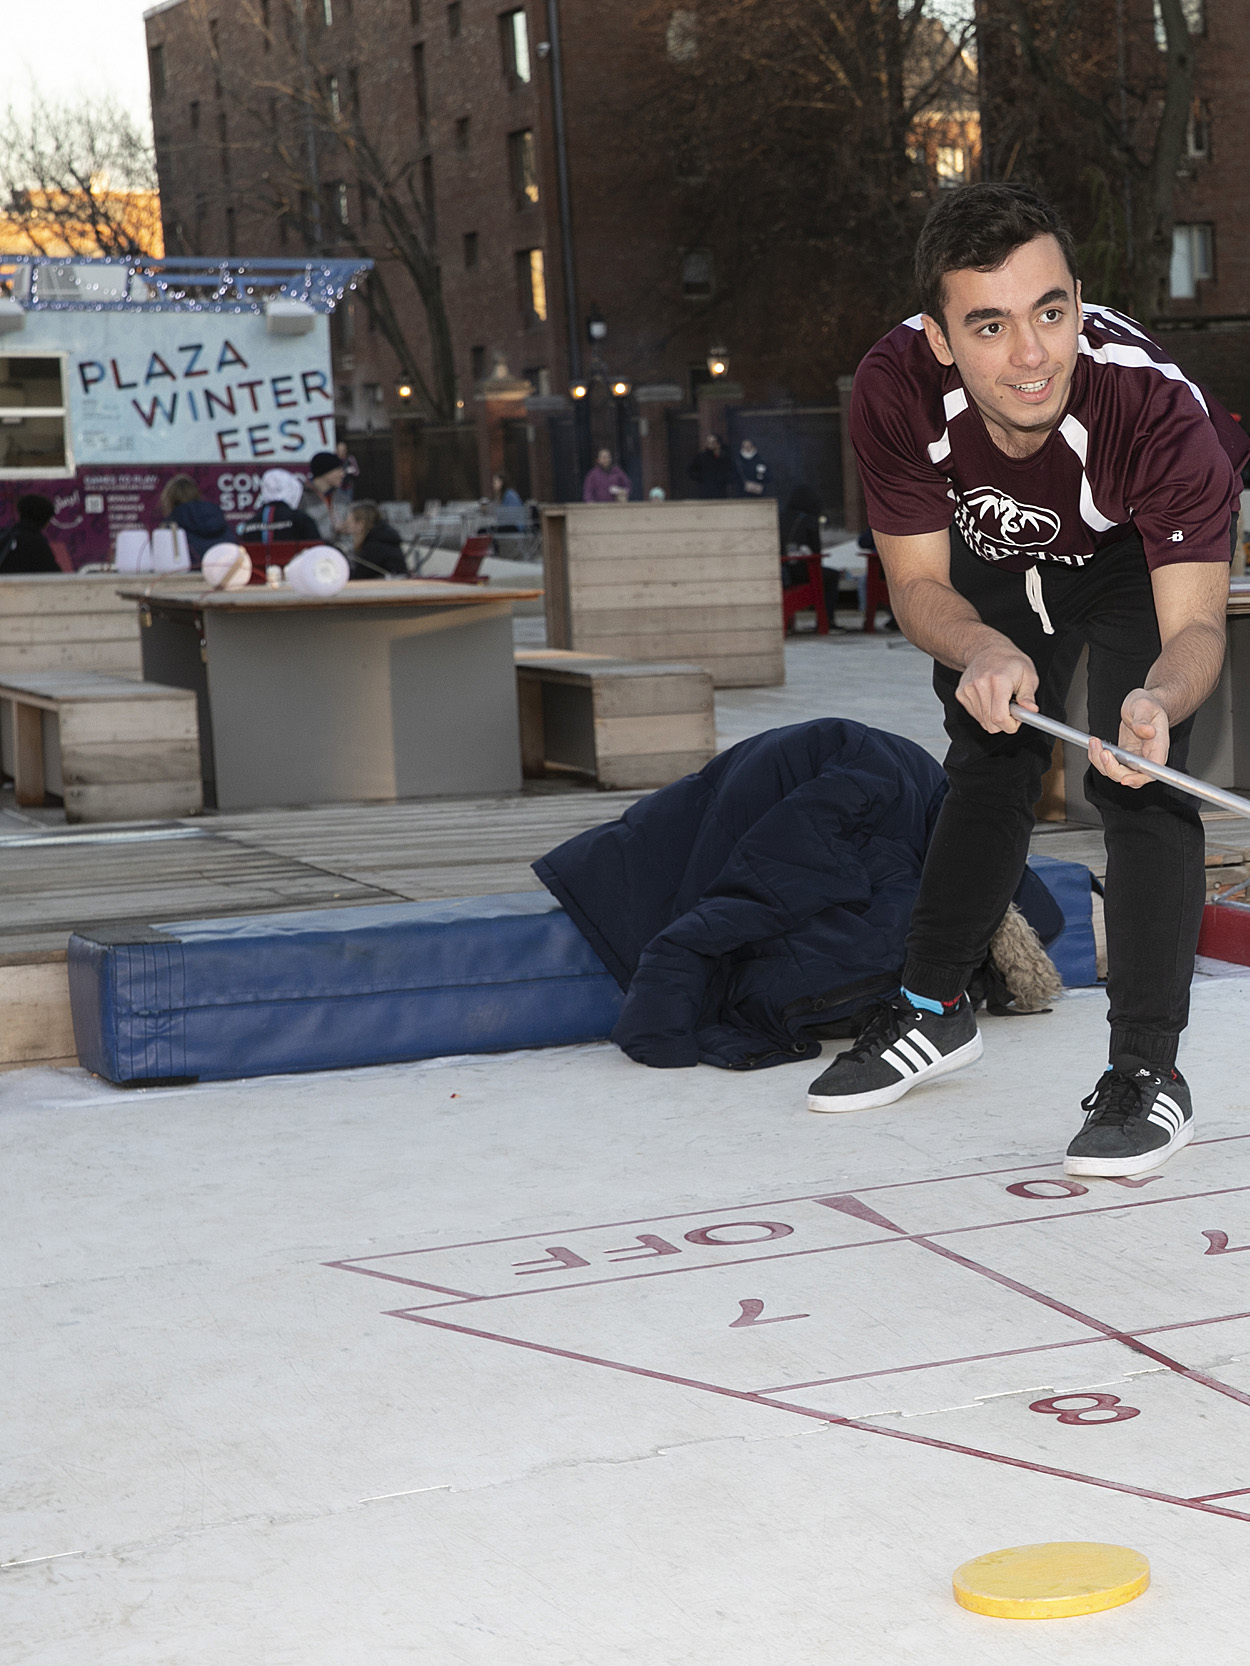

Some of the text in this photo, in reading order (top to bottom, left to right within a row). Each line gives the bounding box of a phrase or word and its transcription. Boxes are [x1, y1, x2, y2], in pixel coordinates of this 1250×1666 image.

[78, 340, 249, 395] PLAZA
[131, 370, 331, 429] WINTER
[216, 413, 335, 462] FEST
[512, 1221, 794, 1275] OFF
[728, 1298, 810, 1328] 7
[1029, 1393, 1141, 1425] 8
